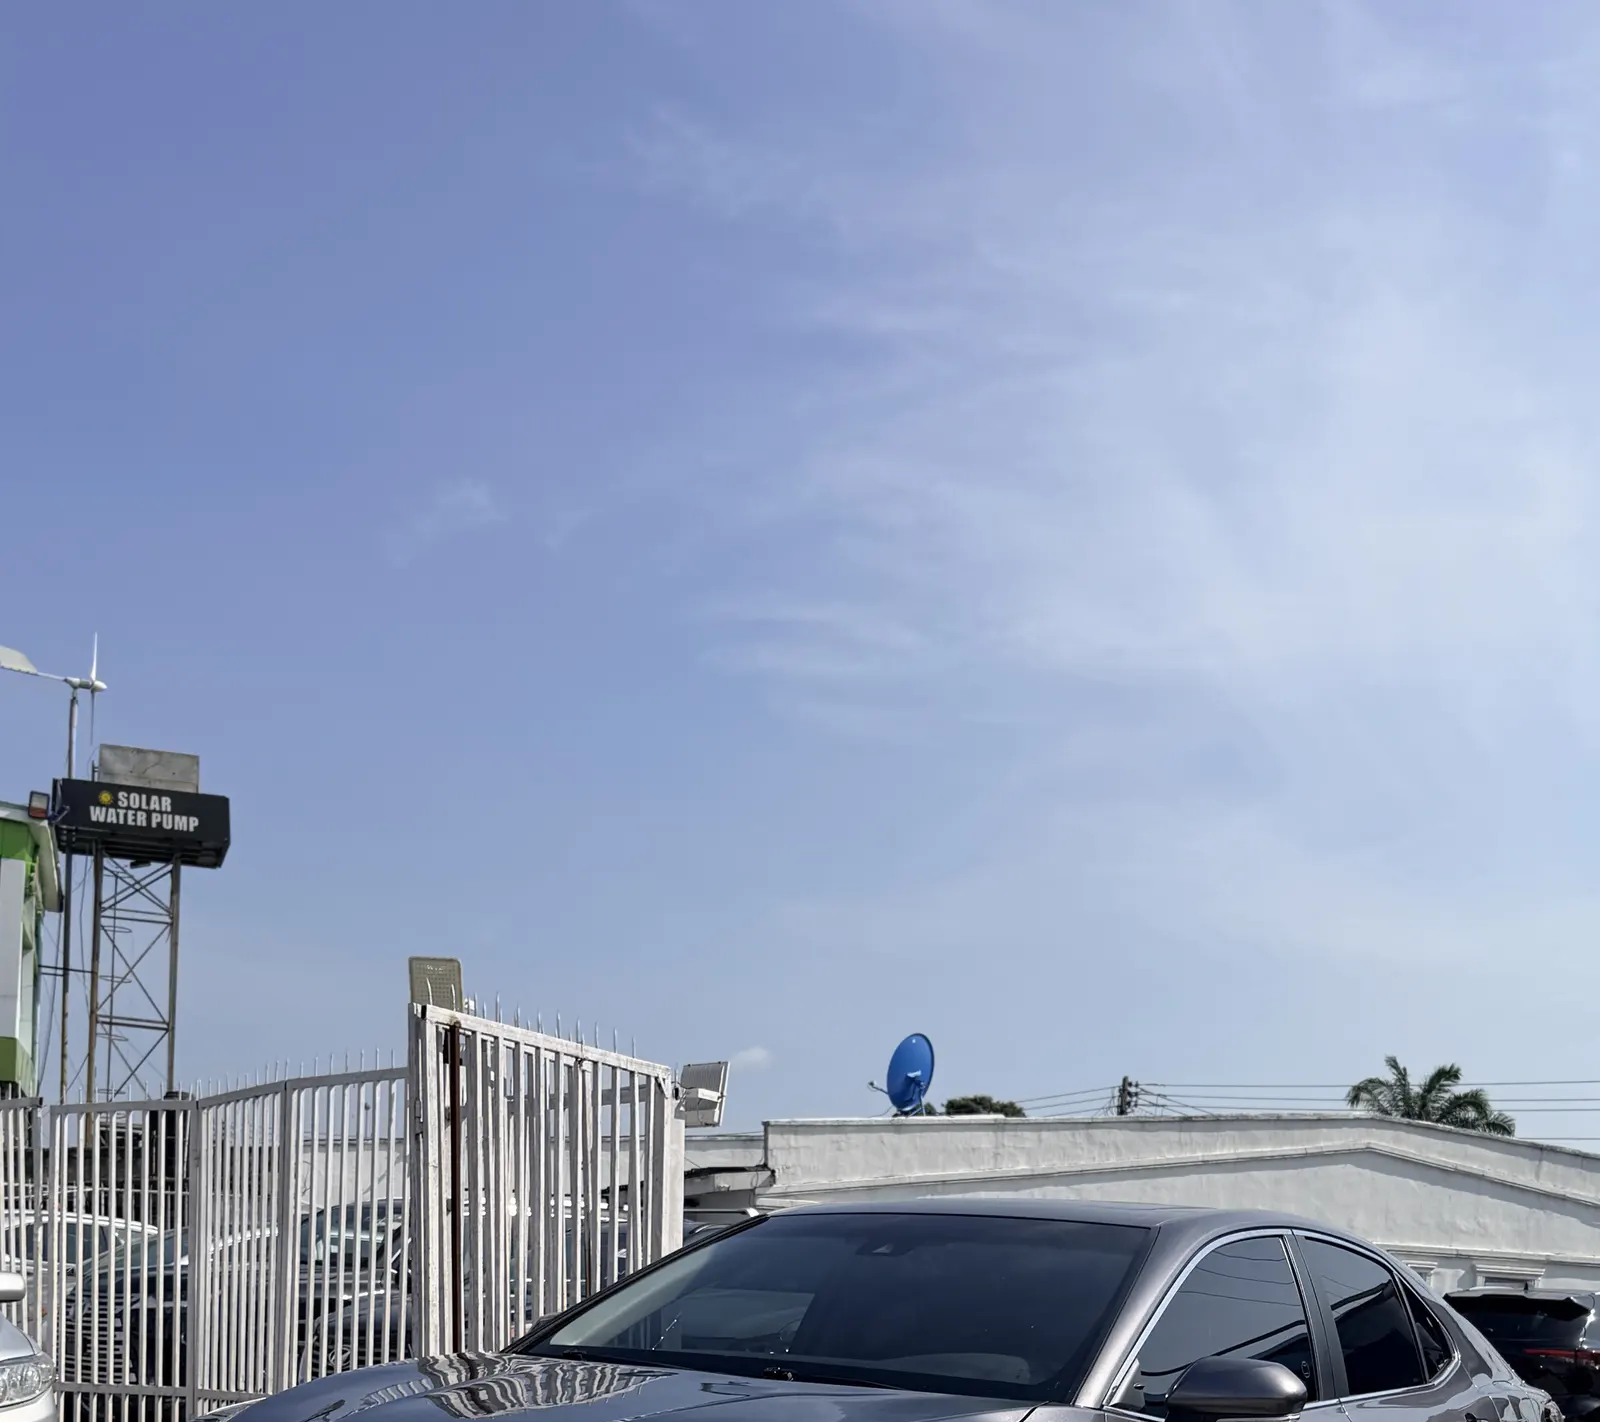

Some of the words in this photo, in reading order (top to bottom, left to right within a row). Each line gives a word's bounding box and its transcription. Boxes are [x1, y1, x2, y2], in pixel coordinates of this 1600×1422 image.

[117, 791, 172, 812] SOLAR
[89, 805, 147, 827] WATER
[151, 812, 199, 832] PUMP
